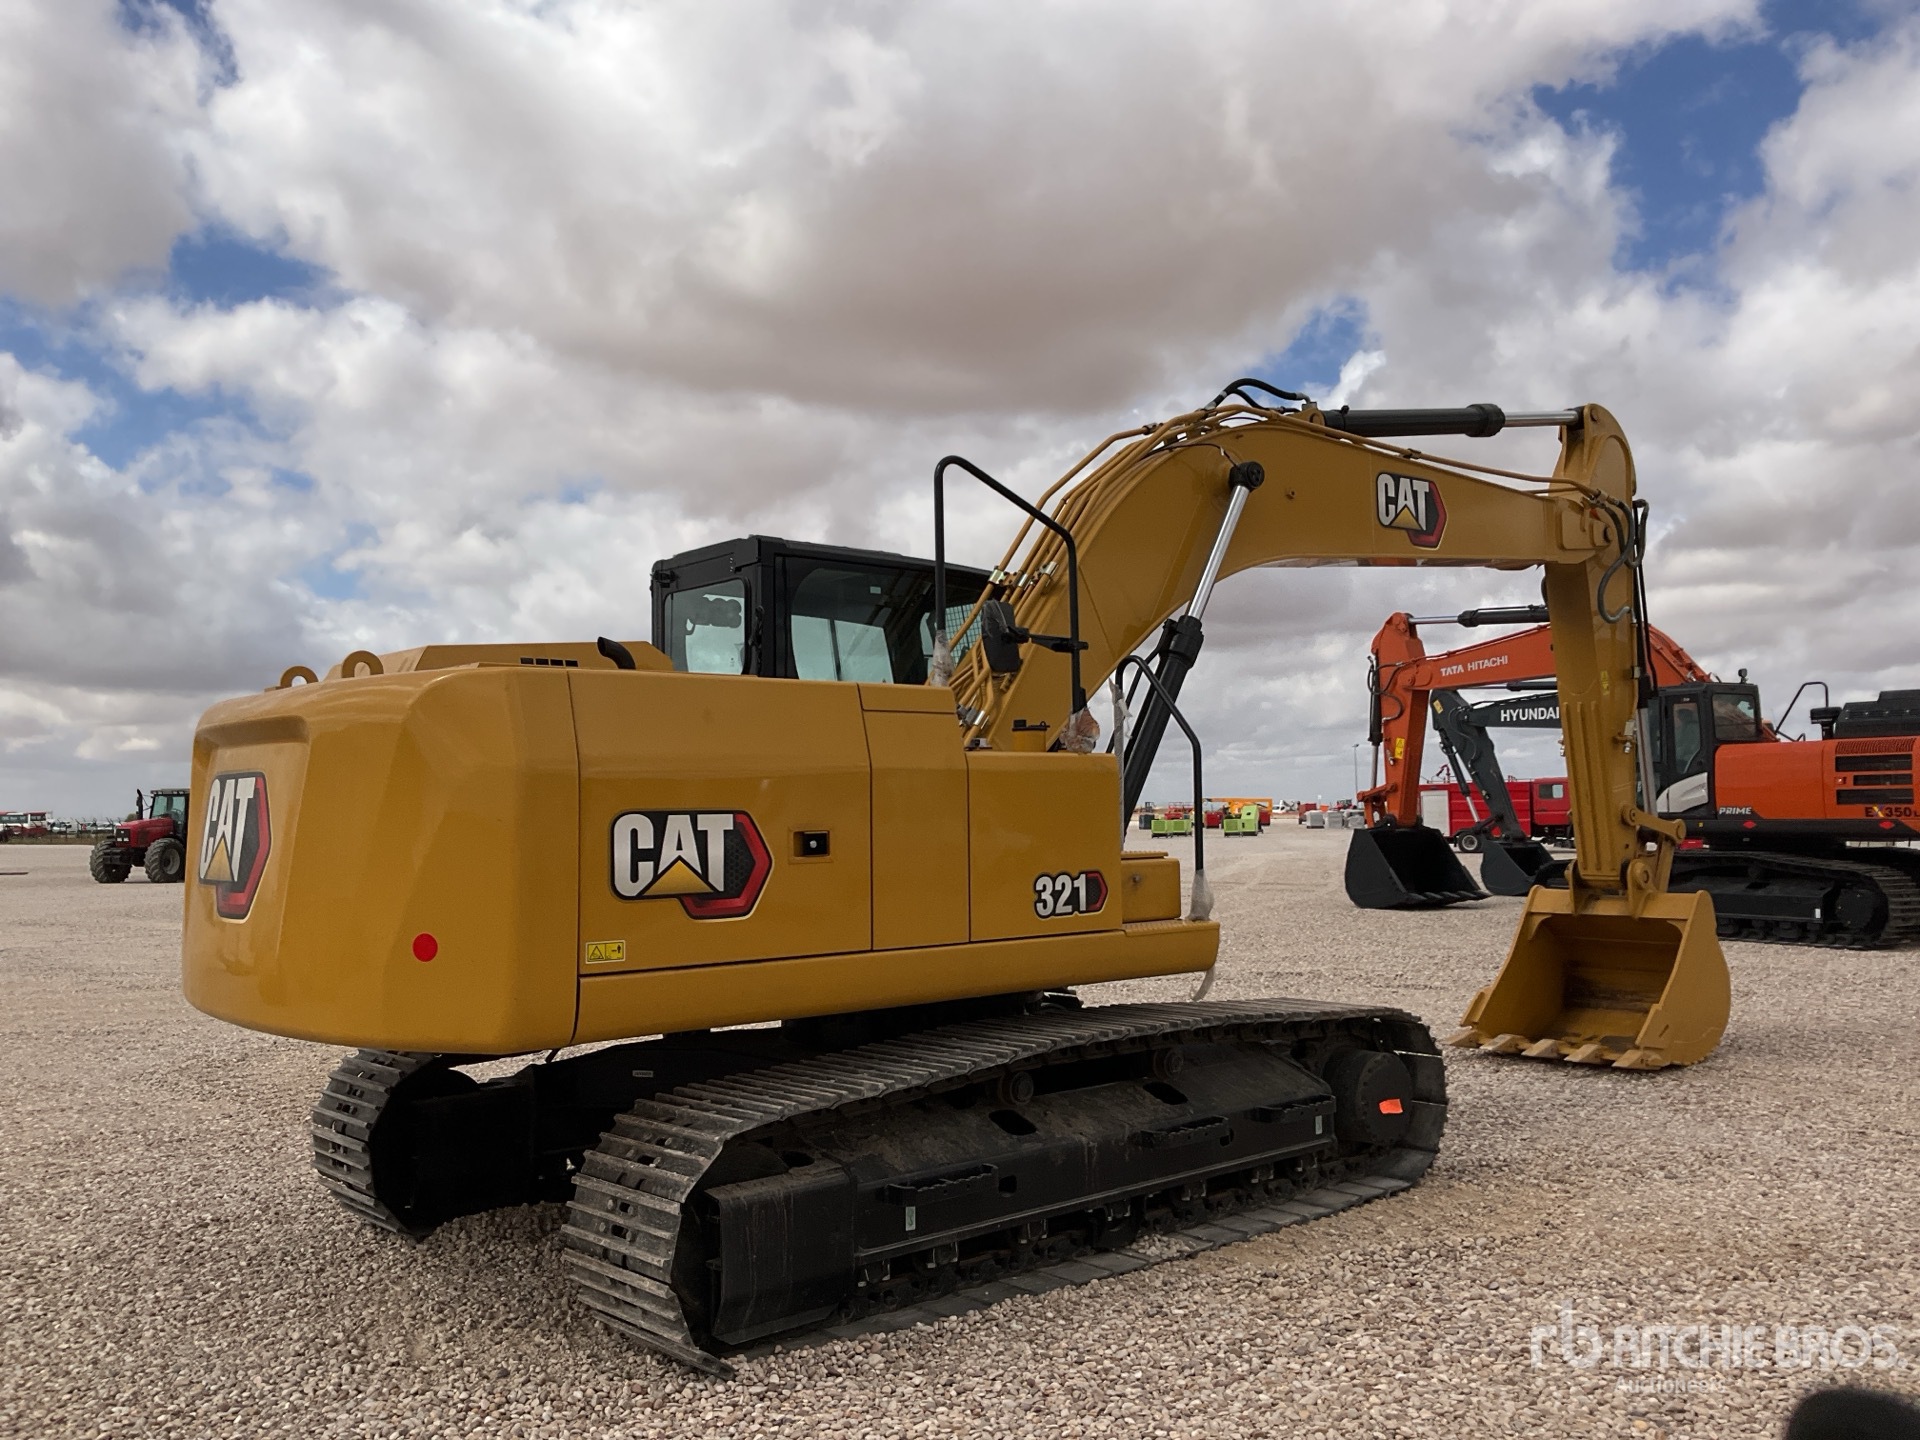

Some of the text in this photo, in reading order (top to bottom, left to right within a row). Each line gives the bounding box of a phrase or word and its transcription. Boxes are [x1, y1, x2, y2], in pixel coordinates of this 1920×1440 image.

[1377, 473, 1430, 531] CAT
[1440, 655, 1509, 676] TATA HITACHI
[1500, 706, 1560, 721] HYUNDAI
[200, 777, 256, 882] CAT
[1719, 806, 1752, 815] PRIME
[613, 813, 734, 897] CAT
[1035, 873, 1087, 916] 321
